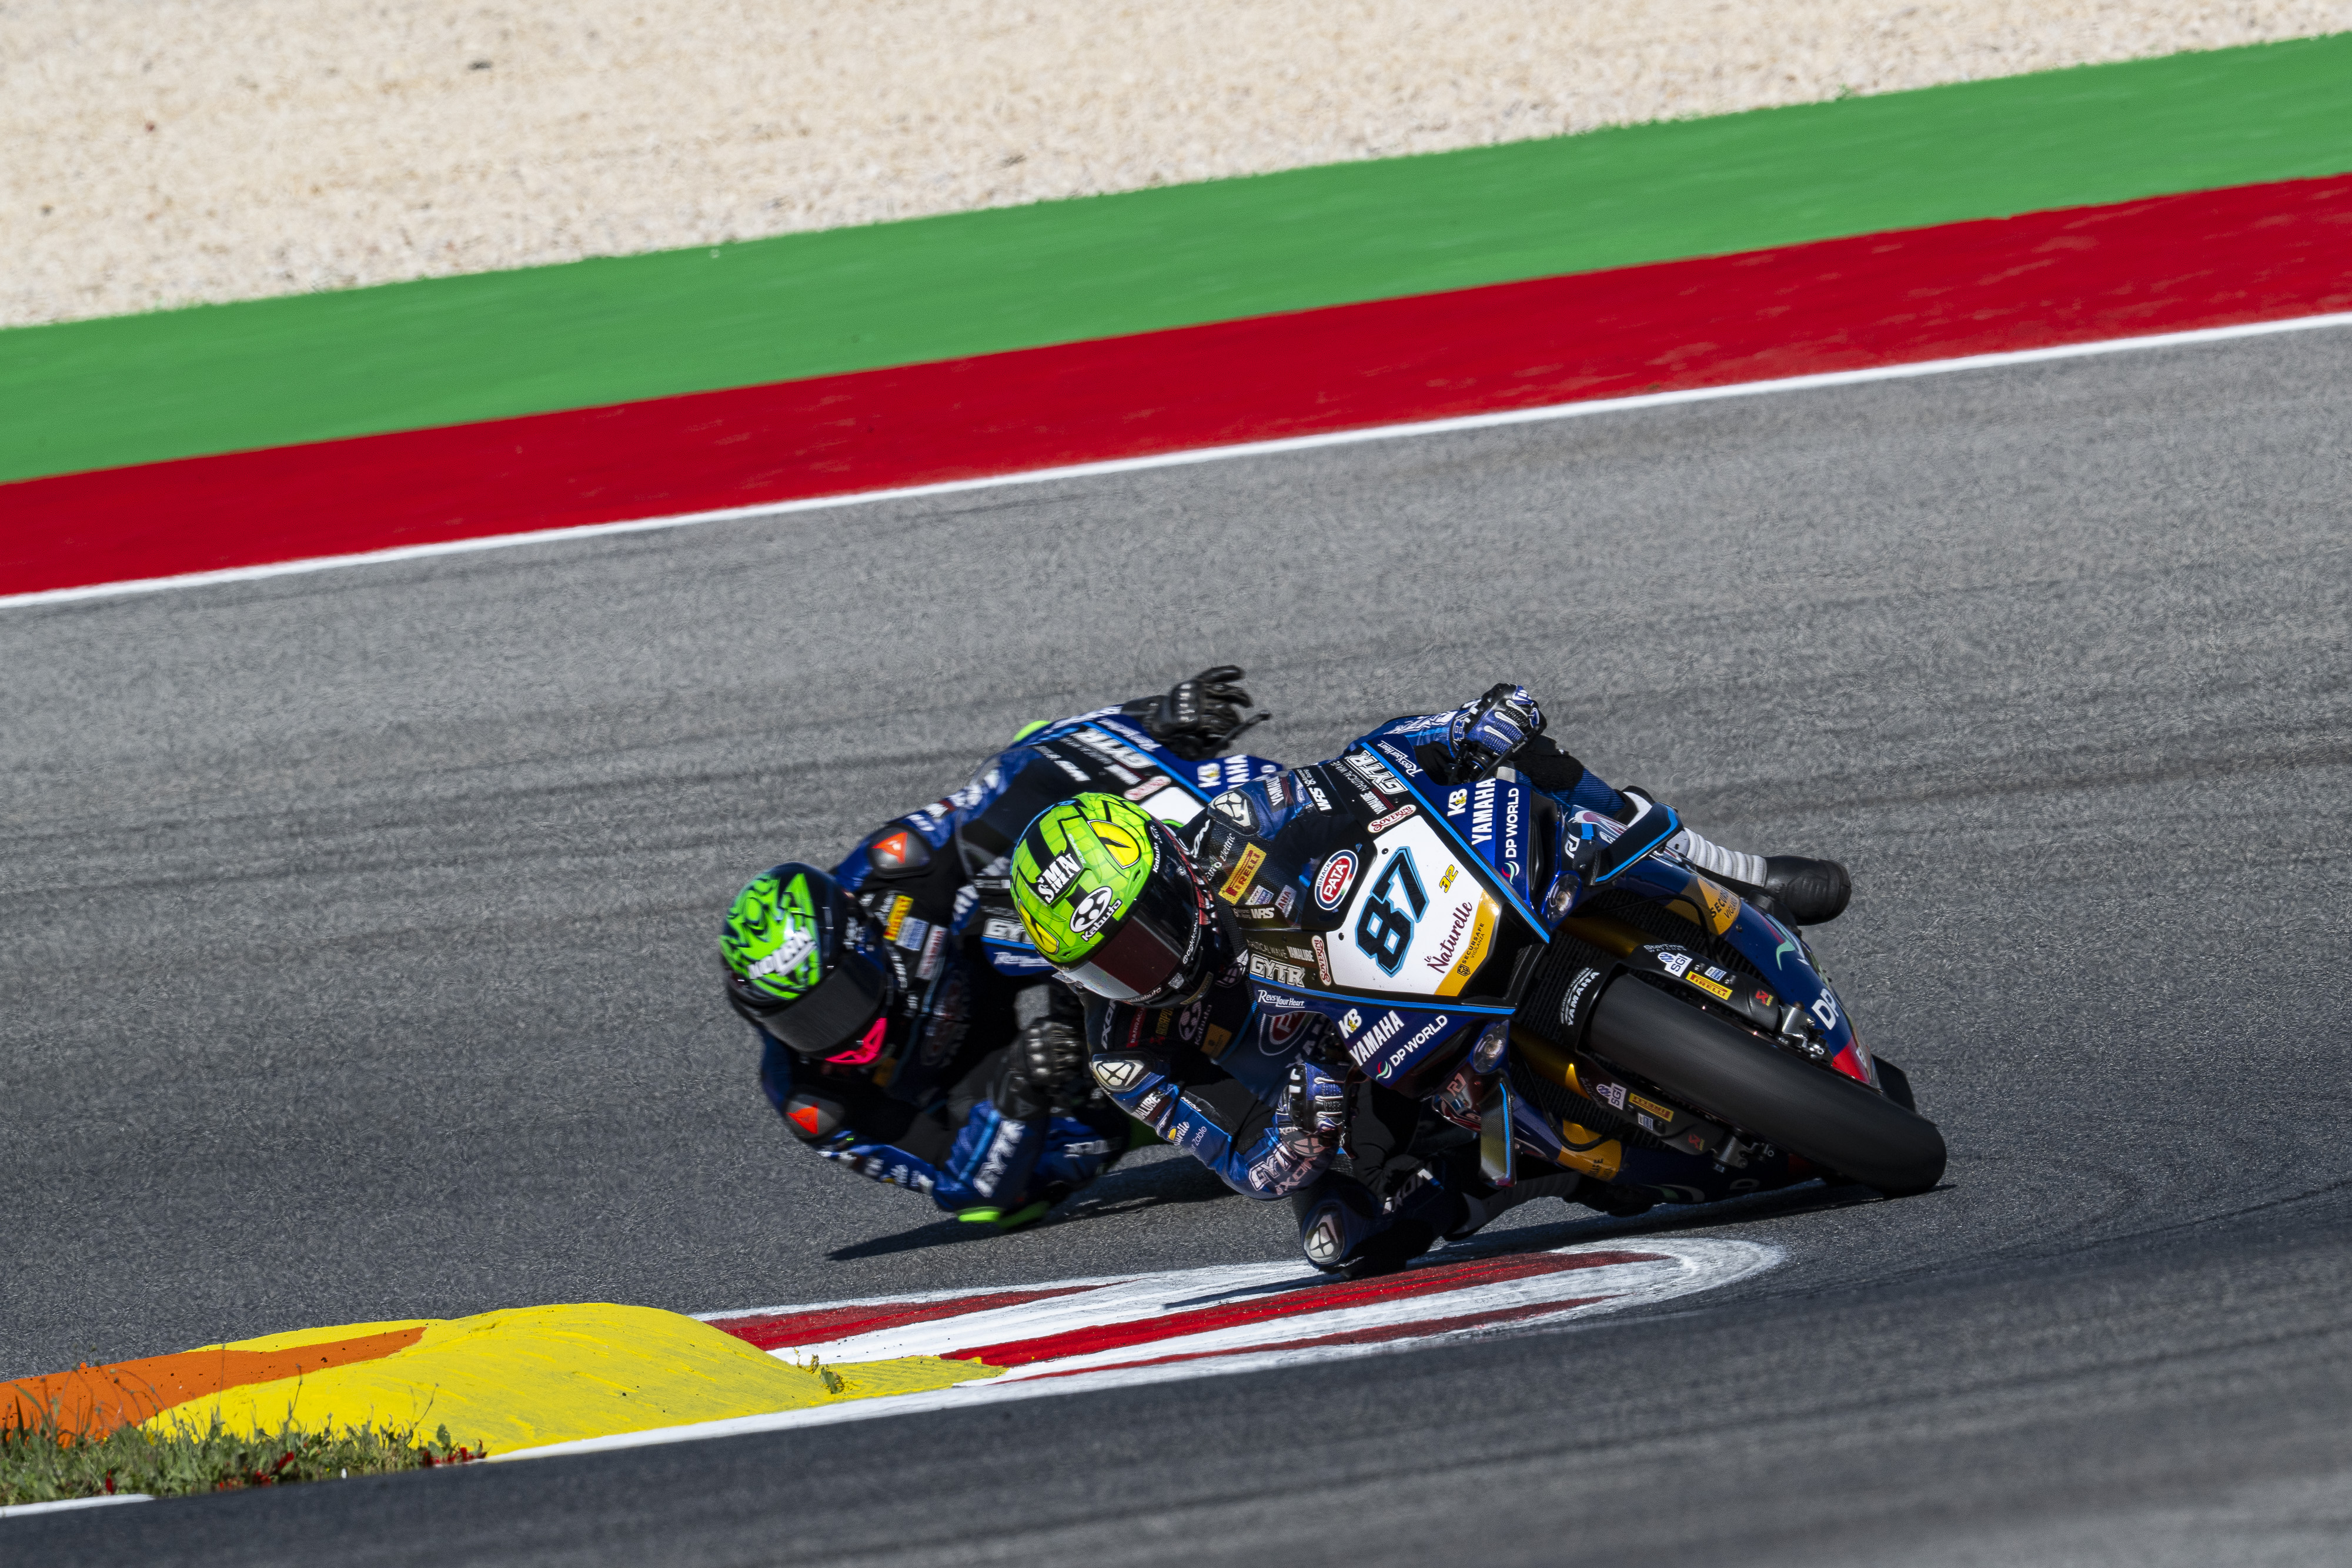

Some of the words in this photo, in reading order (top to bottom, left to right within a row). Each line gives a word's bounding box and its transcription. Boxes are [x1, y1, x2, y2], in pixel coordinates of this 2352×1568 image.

[1344, 750, 1409, 794] GYTR
[1308, 787, 1332, 811] WRS
[1447, 788, 1468, 817] K&B
[1471, 777, 1496, 845] YAMAHA
[1506, 788, 1519, 838] WORLD
[1371, 806, 1414, 831] SOVERINI
[1505, 839, 1517, 858] DP
[1225, 850, 1261, 897] PIRELLI
[1323, 864, 1348, 898] PATA
[1439, 864, 1459, 893] 32
[1251, 907, 1275, 919] WRS
[1355, 846, 1430, 978] 87
[1426, 902, 1472, 974] Naturelle
[1462, 922, 1485, 964] SECURSAFE
[1470, 934, 1485, 958] VIGILANZA
[1250, 954, 1305, 988] GYTR
[1314, 939, 1331, 982] SOVERINI
[1671, 955, 1688, 972] SGI
[1568, 972, 1600, 1025] YAMAHA
[1689, 974, 1728, 997] PIRELLI
[1338, 1008, 1362, 1039] K&B
[1811, 988, 1839, 1030] DP
[1349, 1010, 1405, 1066] YAMAHA
[1389, 1049, 1407, 1067] DP
[1405, 1015, 1448, 1053] WORLD
[1611, 1086, 1623, 1106] SGI
